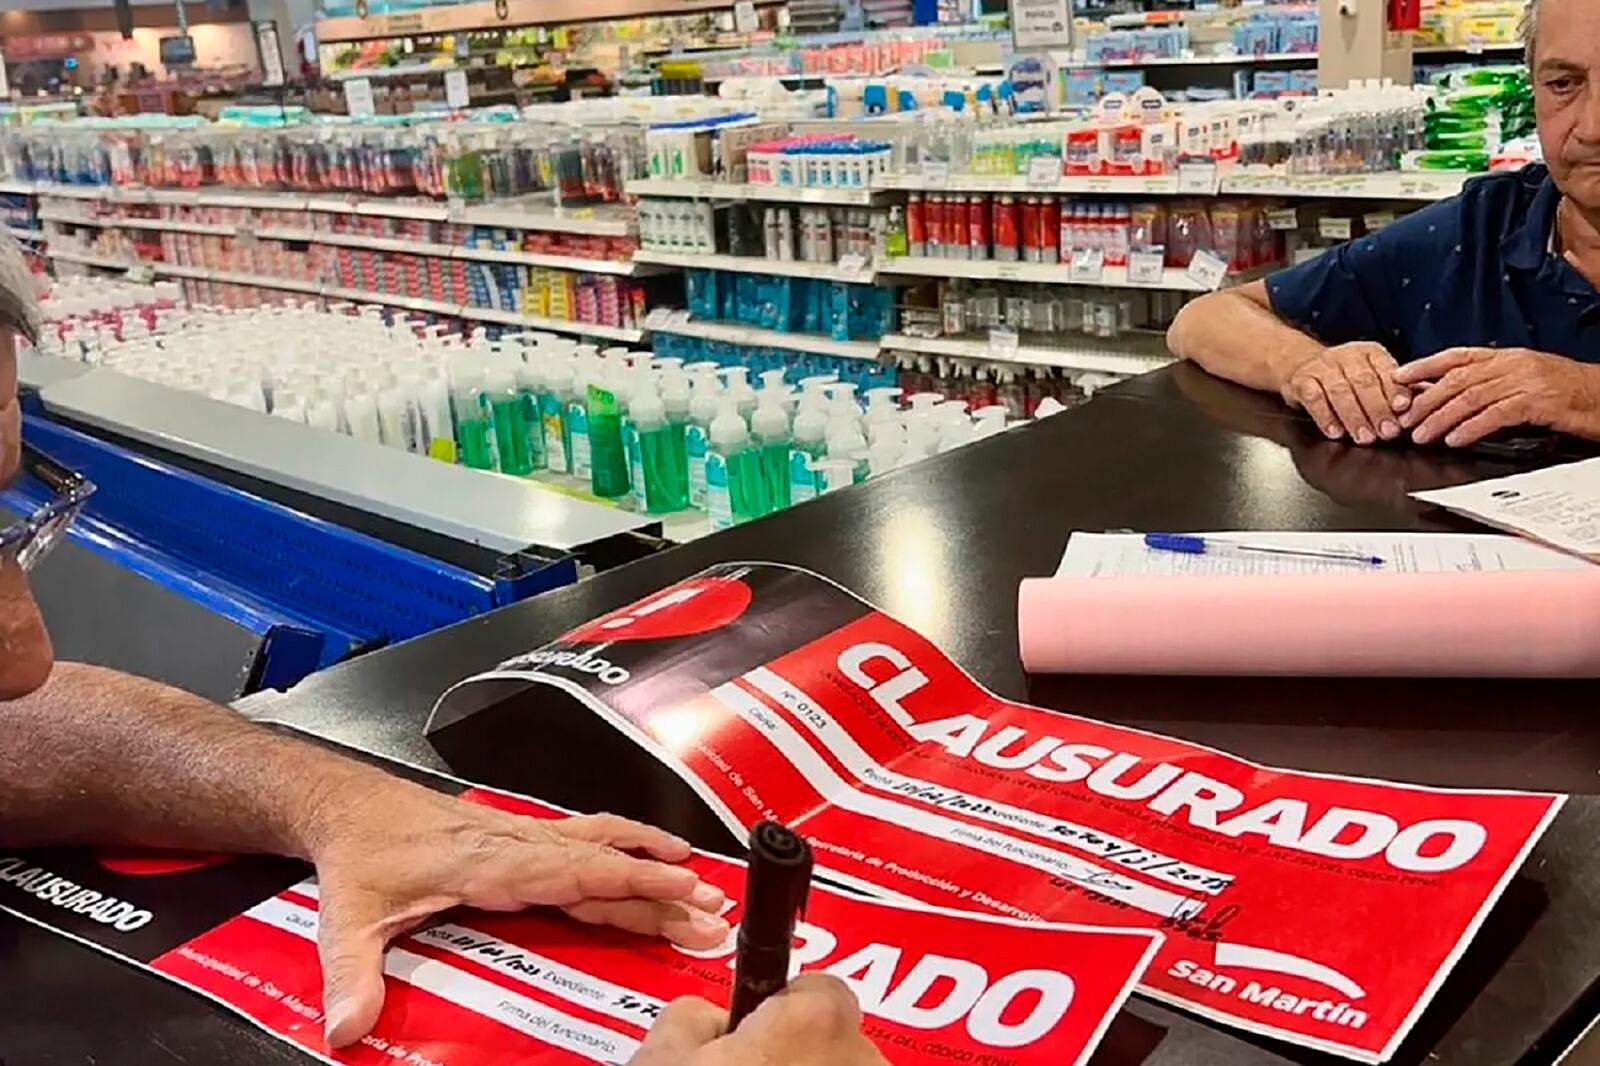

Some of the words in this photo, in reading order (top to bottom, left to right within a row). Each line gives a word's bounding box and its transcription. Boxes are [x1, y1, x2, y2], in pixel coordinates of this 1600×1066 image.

[797, 702, 827, 730] 0123
[837, 642, 1488, 872] CLAUSURADO
[729, 771, 744, 788] de
[742, 786, 765, 811] San
[865, 854, 884, 868] de
[885, 862, 958, 893] Producción
[957, 886, 972, 900] y
[178, 946, 249, 980] Municipalidad
[243, 973, 261, 988] de
[258, 981, 284, 999] San
[497, 1001, 531, 1020] Firma
[529, 1013, 551, 1028] del
[1238, 981, 1369, 1029] Martín
[386, 1043, 408, 1059] de
